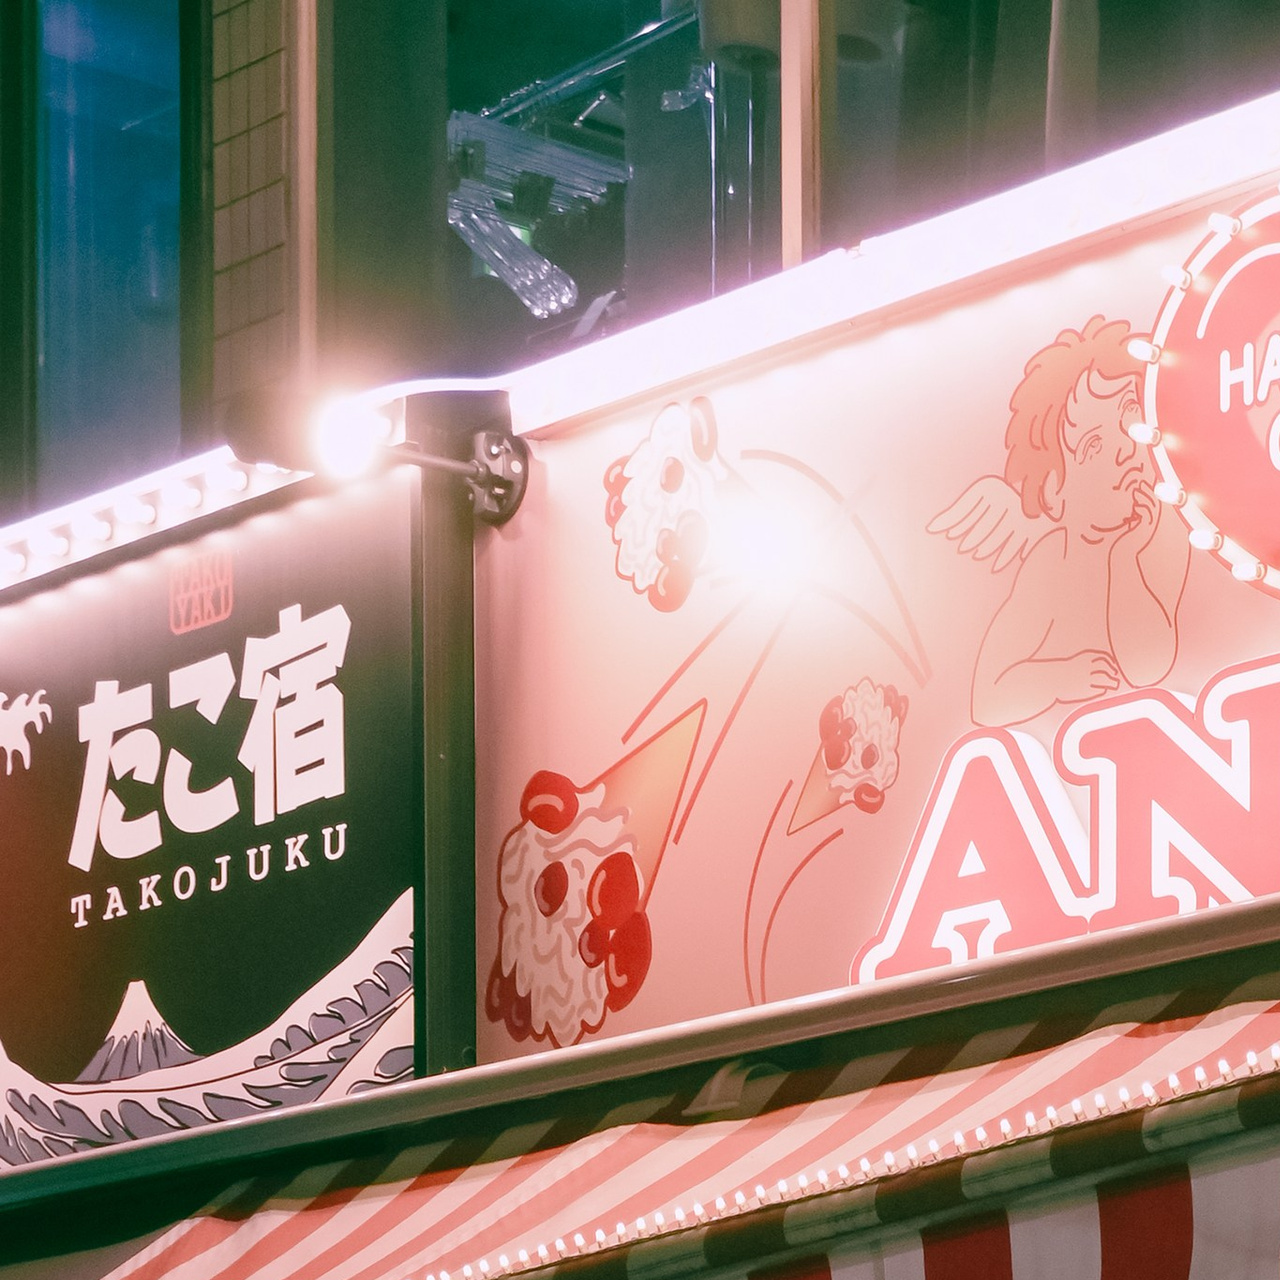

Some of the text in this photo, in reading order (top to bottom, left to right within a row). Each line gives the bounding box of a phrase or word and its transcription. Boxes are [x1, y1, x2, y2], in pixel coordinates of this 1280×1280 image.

[68, 603, 352, 872] たこ宿
[70, 823, 348, 928] TAKOJUKU
